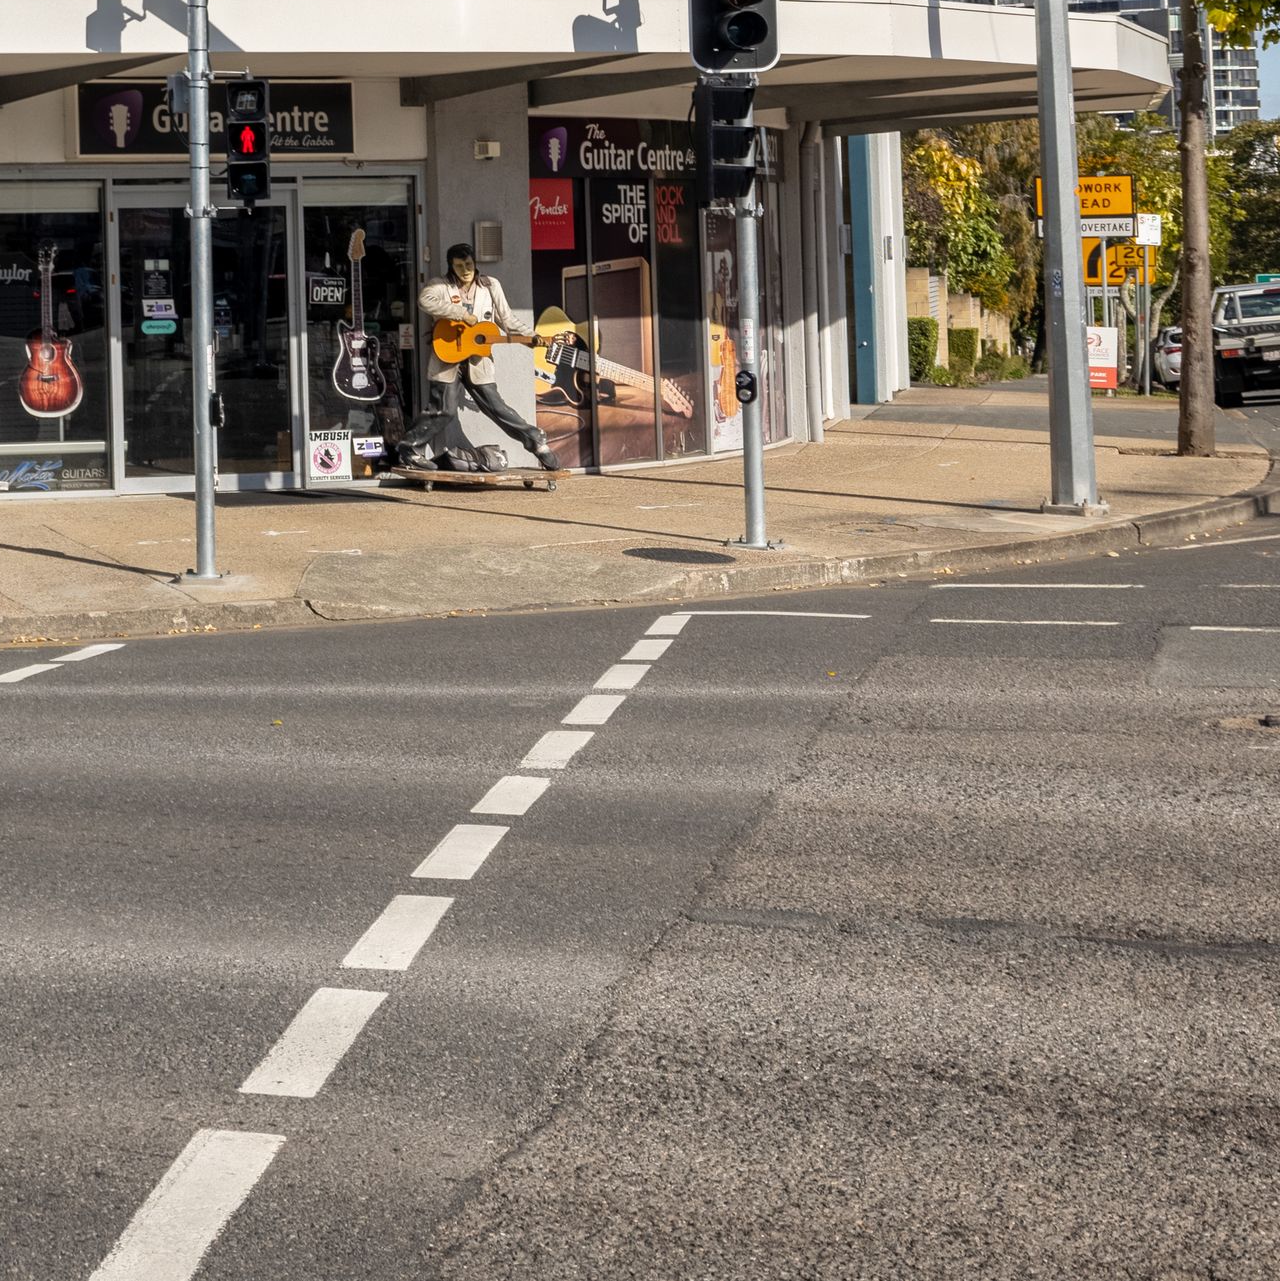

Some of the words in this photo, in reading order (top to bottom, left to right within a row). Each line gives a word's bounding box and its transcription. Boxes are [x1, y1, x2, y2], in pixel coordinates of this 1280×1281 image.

[585, 123, 606, 140] The
[302, 134, 335, 148] Gabba
[579, 140, 634, 171] Guitar
[637, 141, 685, 171] Centre
[617, 184, 646, 205] THE
[529, 196, 569, 220] Fender
[602, 203, 647, 224] SPIRIT
[628, 223, 648, 243] OF
[1081, 223, 1131, 233] OVERTAKE
[313, 286, 343, 302] OPEN
[61, 468, 105, 479] GUITARS
